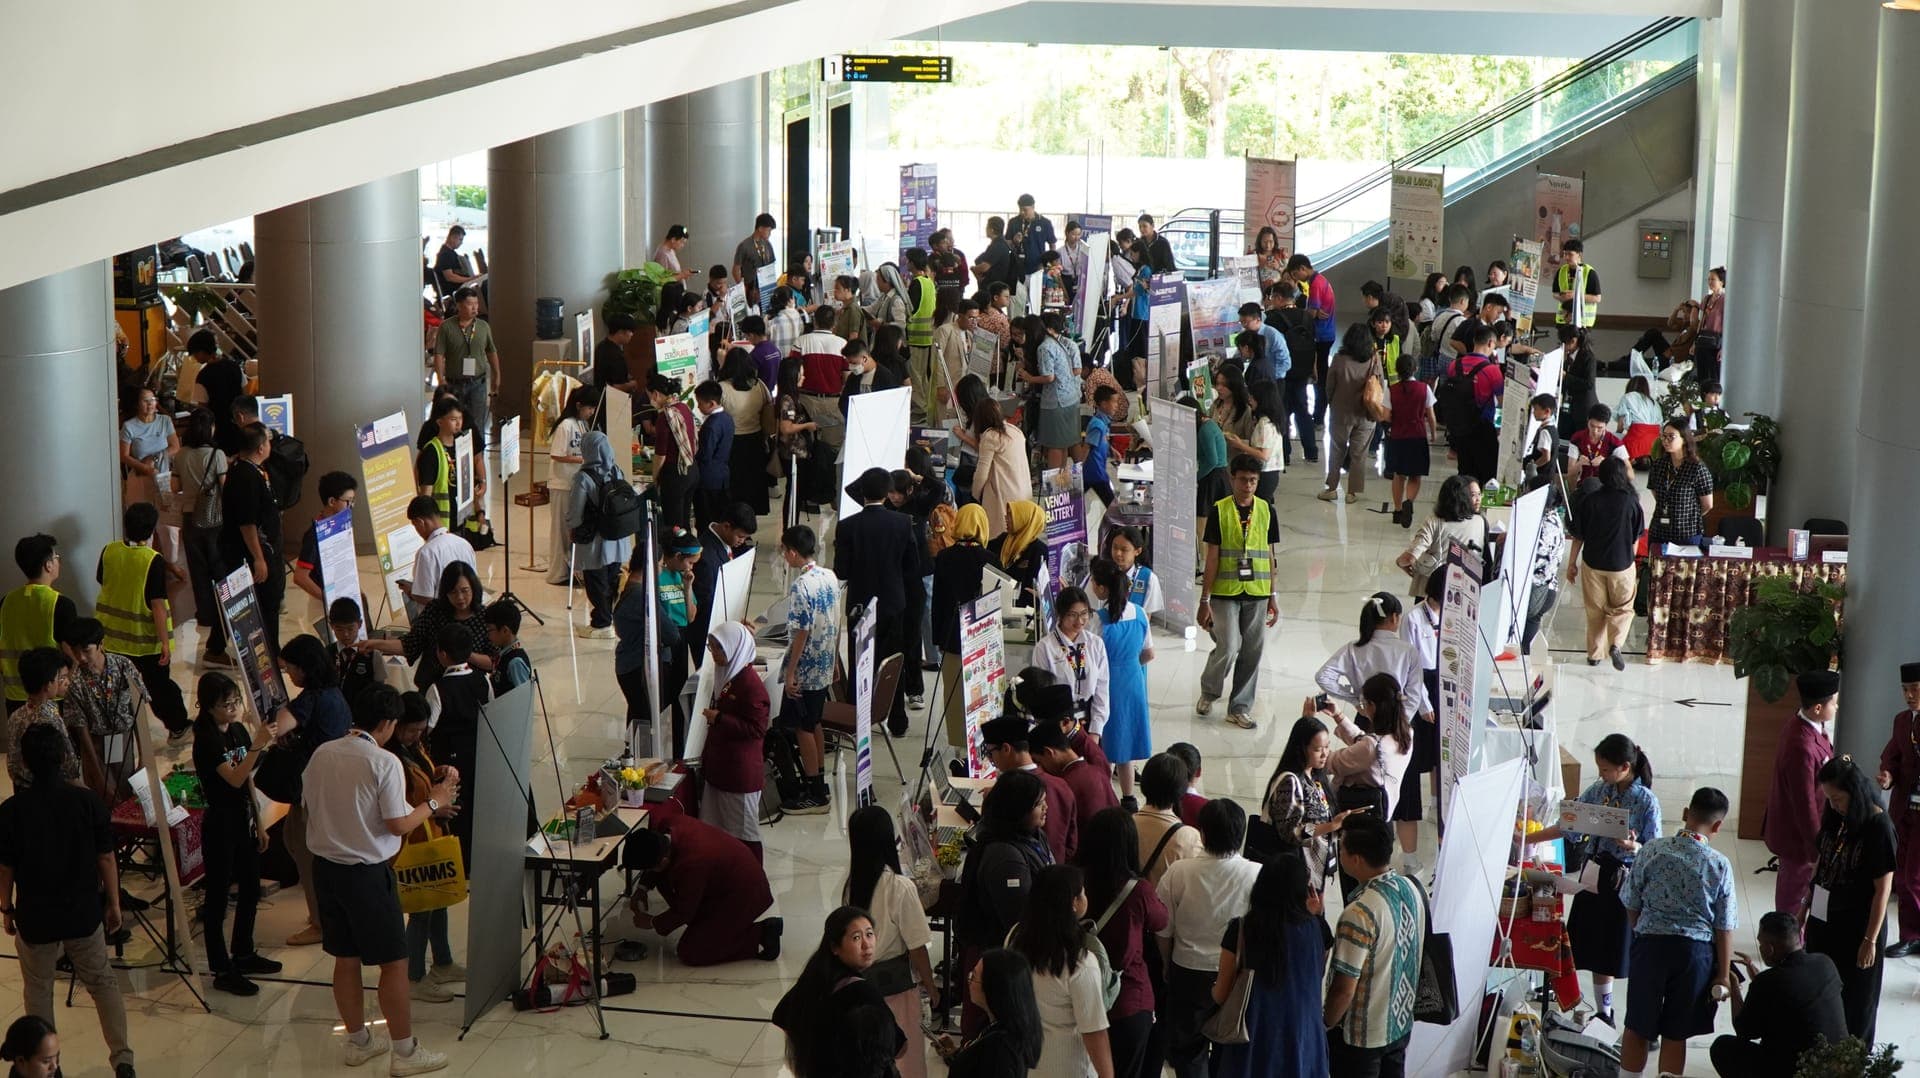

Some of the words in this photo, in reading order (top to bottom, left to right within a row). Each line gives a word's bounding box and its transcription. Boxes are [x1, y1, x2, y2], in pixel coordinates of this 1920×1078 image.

[831, 61, 837, 75] 1
[1044, 491, 1070, 509] VENOM
[1045, 504, 1074, 523] BATTERY
